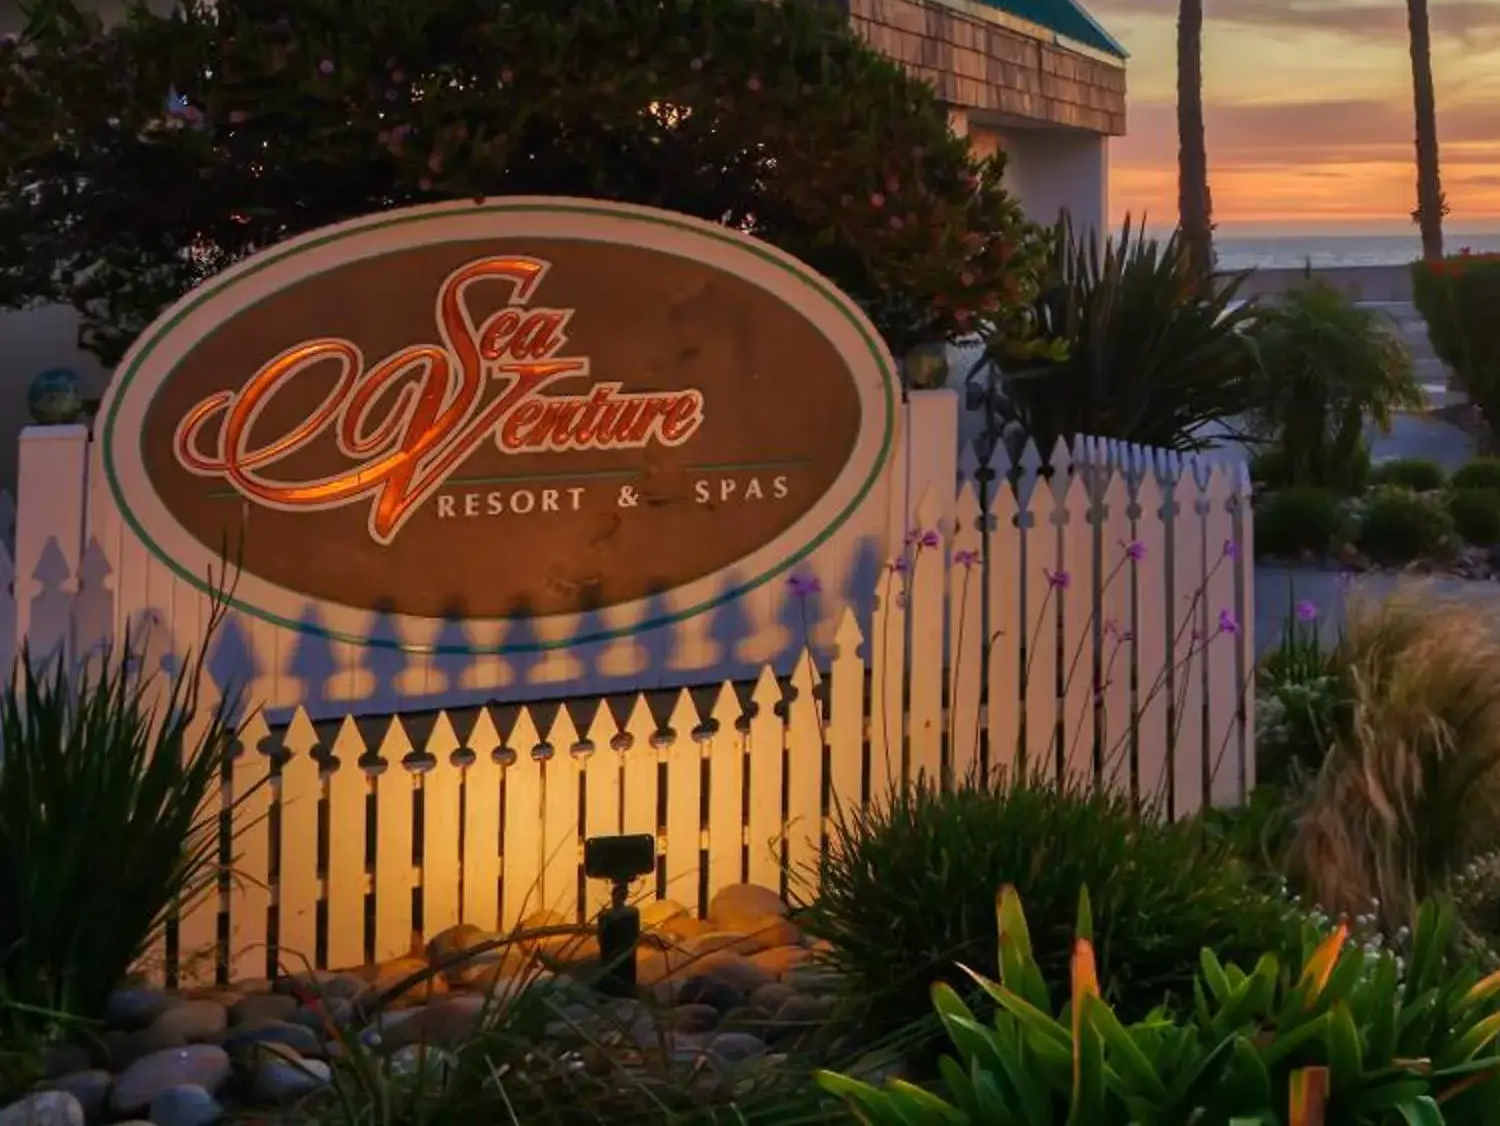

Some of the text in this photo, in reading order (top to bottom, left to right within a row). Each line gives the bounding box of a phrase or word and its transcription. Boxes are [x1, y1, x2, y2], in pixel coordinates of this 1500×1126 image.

[437, 475, 790, 519] RESORT & SPAS
